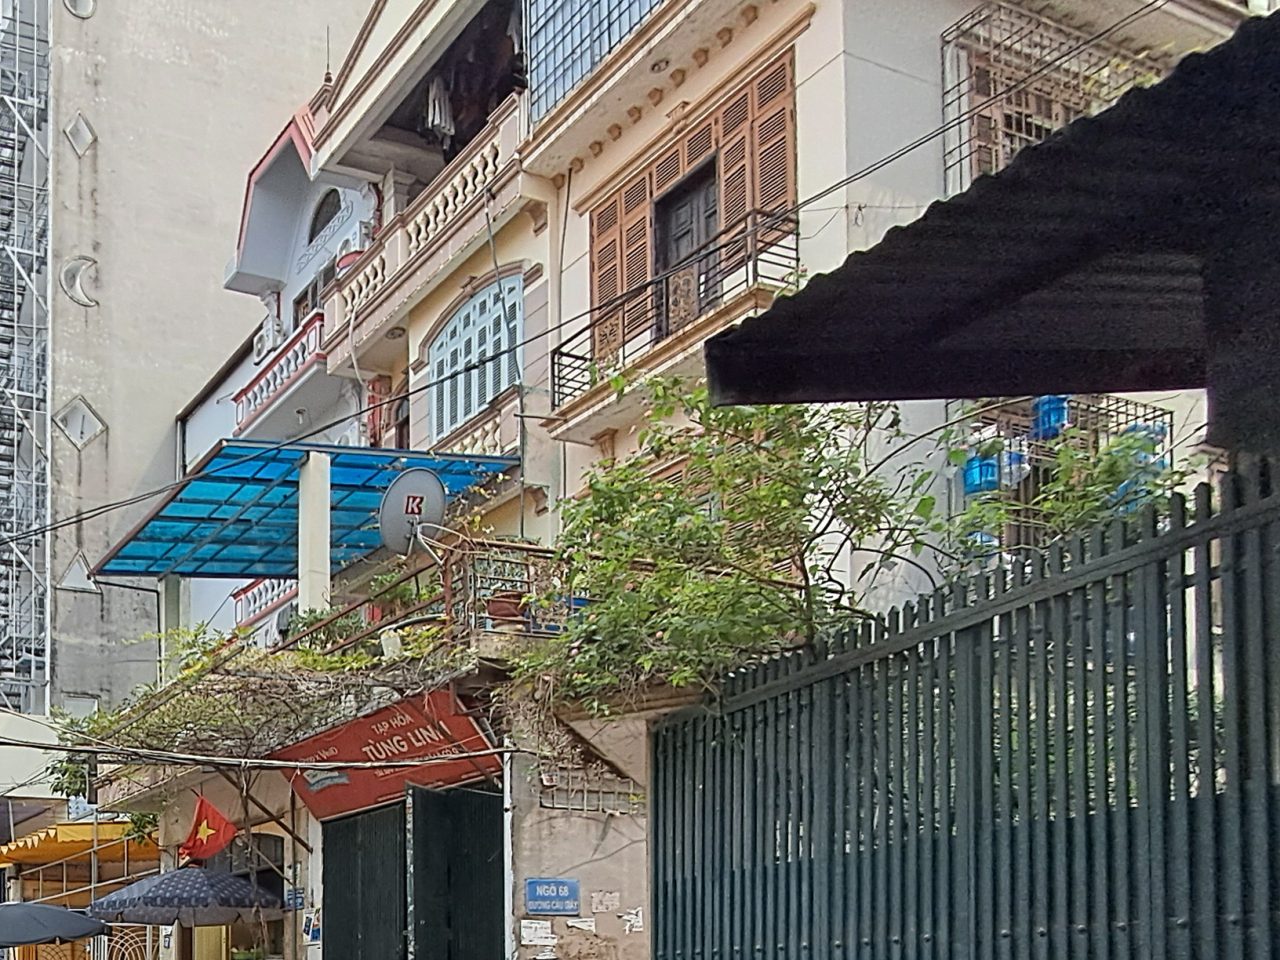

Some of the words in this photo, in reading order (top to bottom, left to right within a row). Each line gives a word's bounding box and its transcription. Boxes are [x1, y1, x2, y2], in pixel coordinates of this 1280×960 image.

[406, 496, 423, 514] K
[371, 721, 390, 736] TẠP
[361, 735, 409, 761] TÙNG
[536, 883, 557, 896] NGÕ
[558, 885, 569, 896] 68
